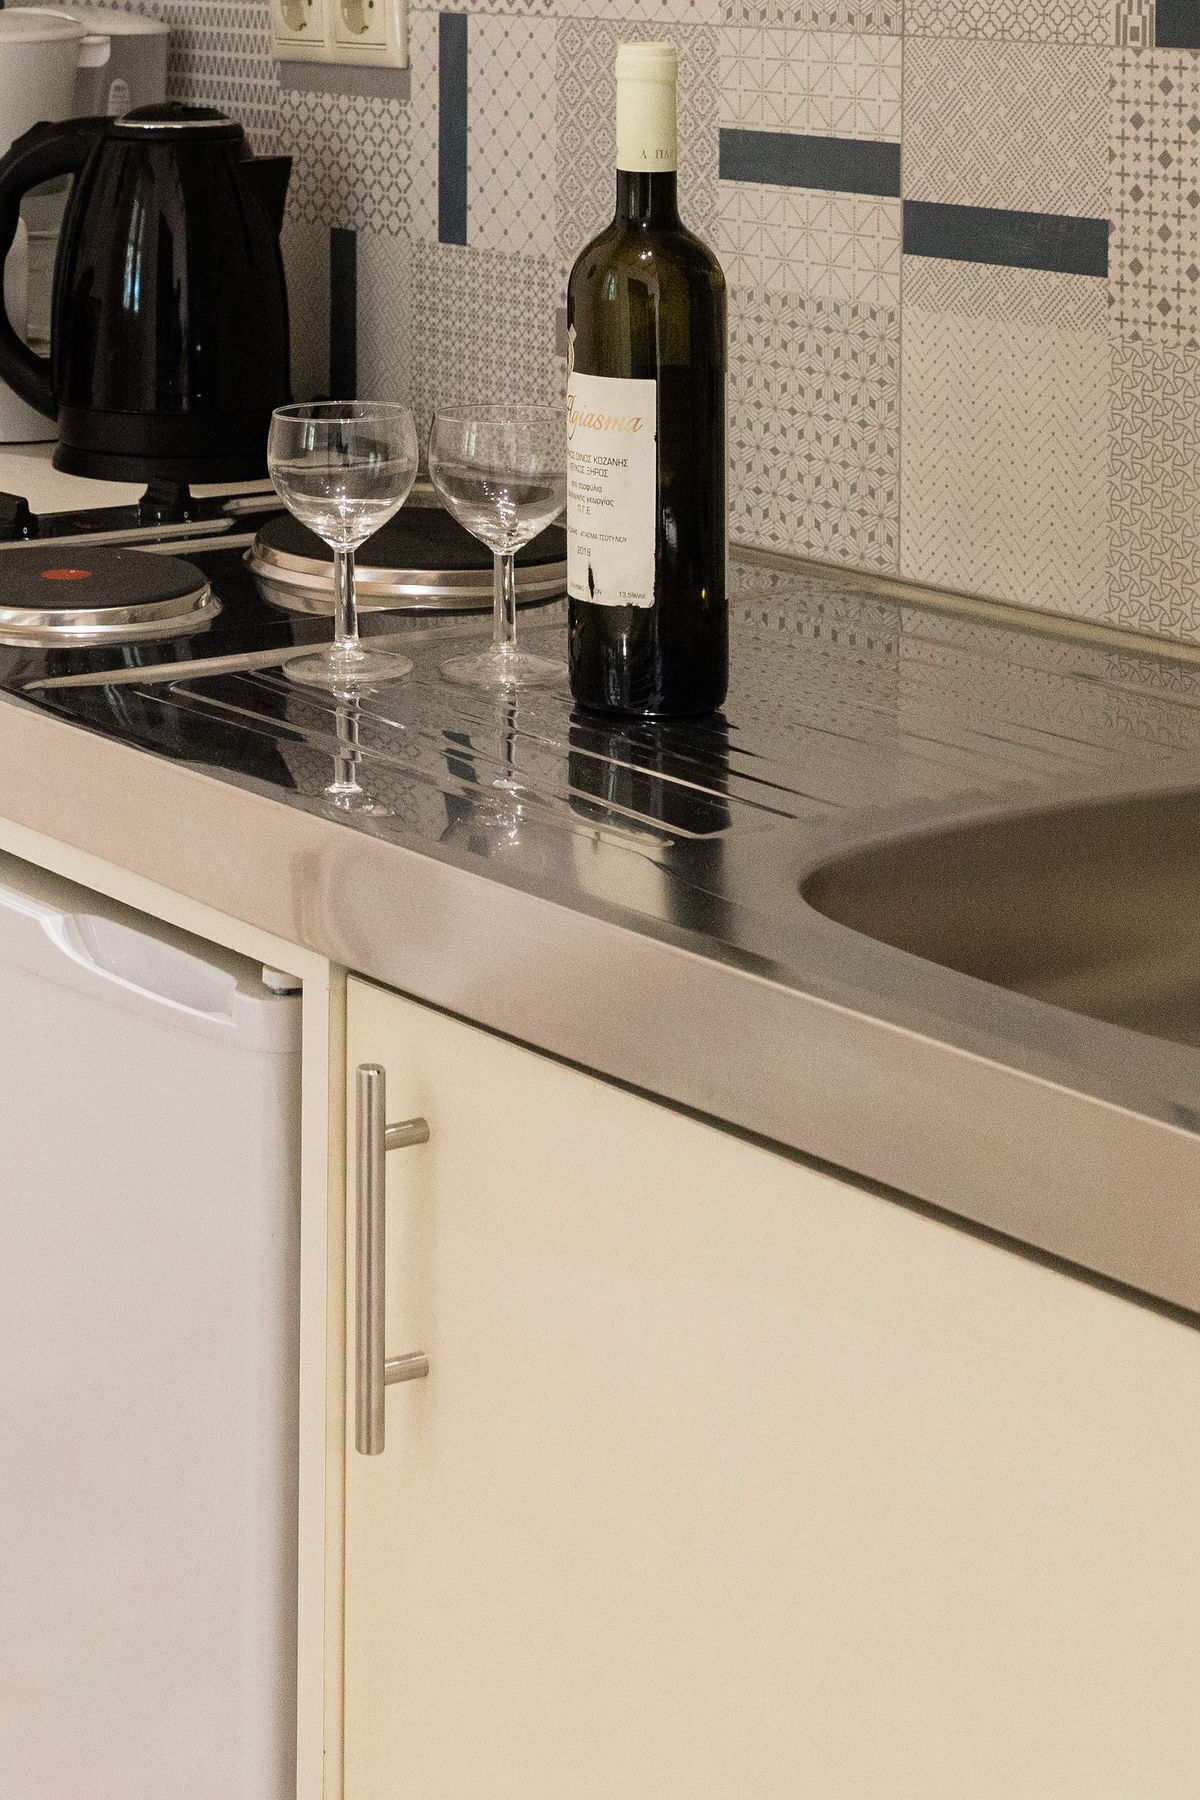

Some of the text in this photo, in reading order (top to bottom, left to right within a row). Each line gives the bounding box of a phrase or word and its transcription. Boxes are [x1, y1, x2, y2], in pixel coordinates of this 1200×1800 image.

[566, 394, 644, 440] Agiasma
[593, 455, 628, 468] ΚΟΖΑΝΗΣ
[586, 466, 609, 478] ΞΗΡΟΣ
[183, 511, 189, 519] 0
[22, 527, 28, 535] 0
[577, 545, 592, 557] 2018
